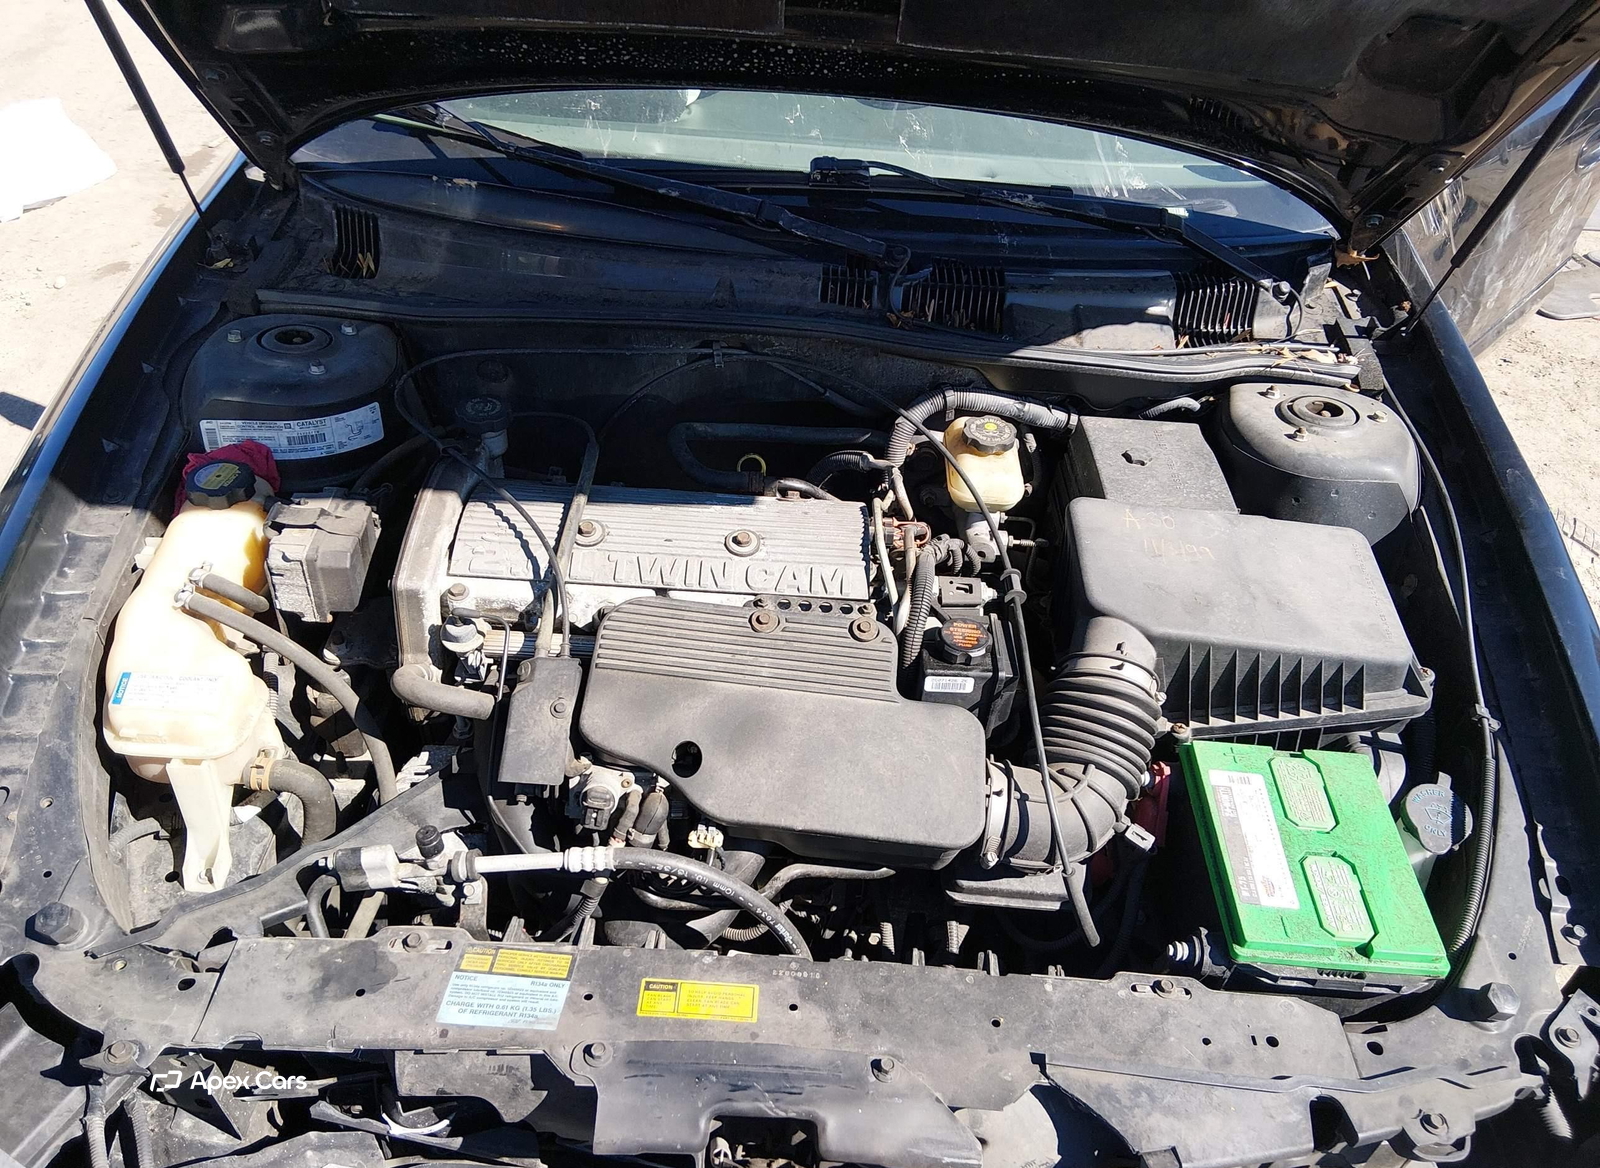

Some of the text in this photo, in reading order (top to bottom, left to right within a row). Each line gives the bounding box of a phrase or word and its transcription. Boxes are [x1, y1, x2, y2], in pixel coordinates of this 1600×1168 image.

[608, 554, 728, 589] TWIN
[744, 563, 852, 597] CAM
[116, 677, 128, 699] NOTICE
[1412, 788, 1445, 804] WASHER
[713, 882, 735, 897] 10mm
[469, 1009, 517, 1017] REFRIGERANT
